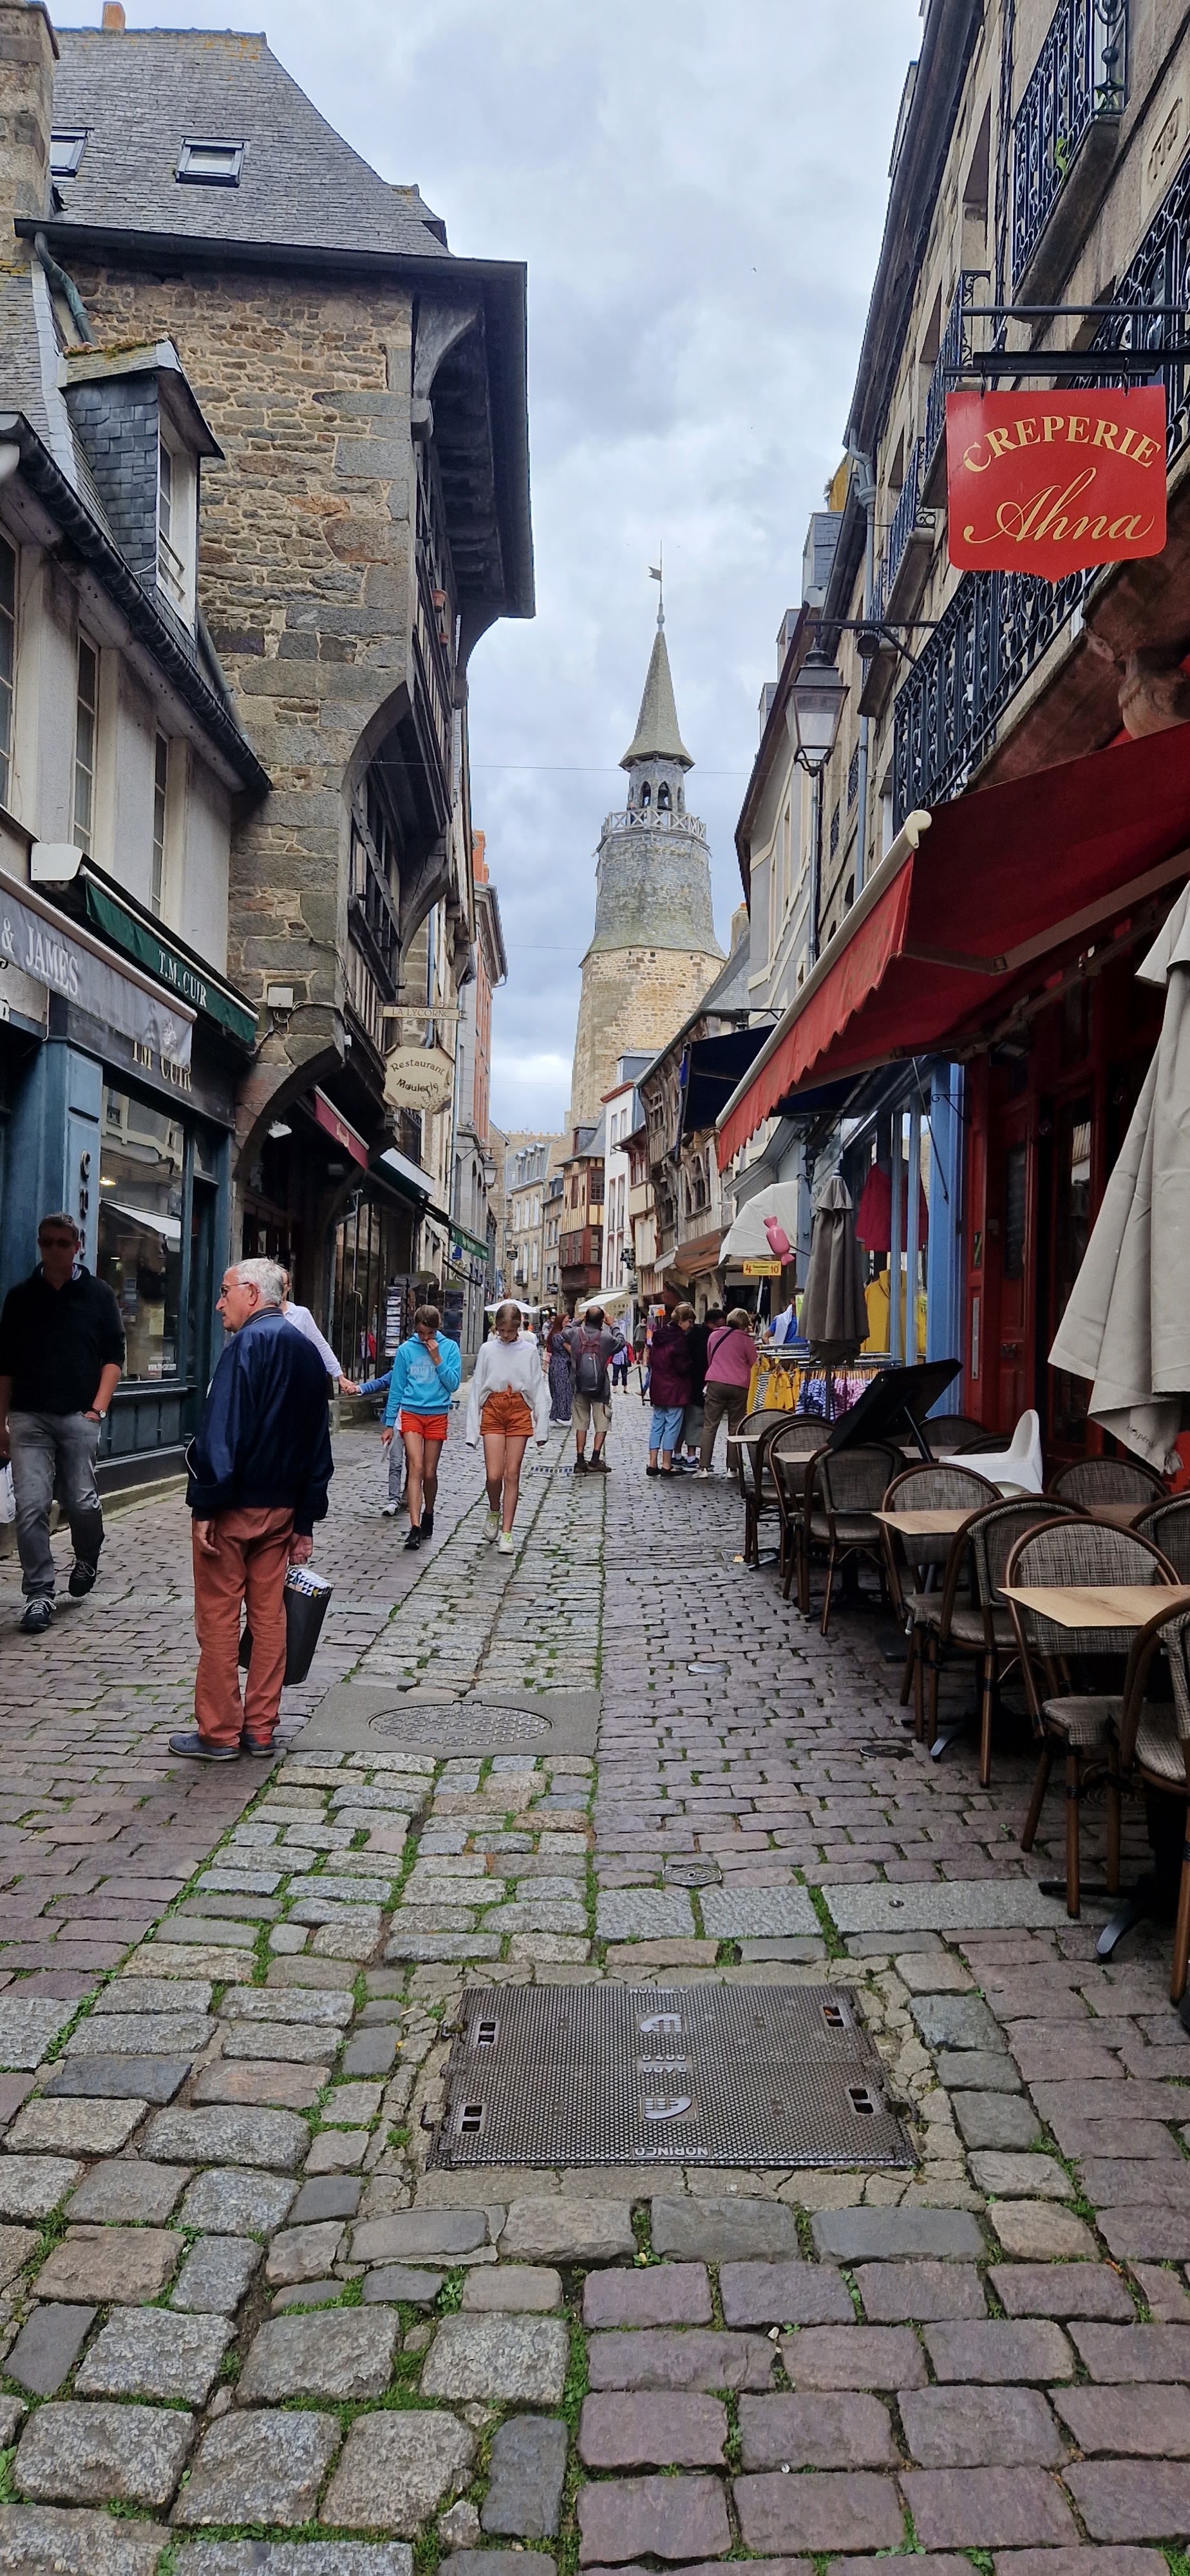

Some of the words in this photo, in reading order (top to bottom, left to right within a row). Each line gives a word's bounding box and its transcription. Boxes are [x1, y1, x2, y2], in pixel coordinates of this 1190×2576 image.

[963, 416, 1162, 473] CREPERIE
[963, 467, 1155, 544] Ahna
[1, 917, 14, 953] &
[26, 924, 78, 995] JAMES
[158, 949, 181, 987] T.M.
[183, 971, 207, 1008] CUIR
[407, 1008, 449, 1018] LYCORNE
[160, 1056, 192, 1092] CUIR
[390, 1059, 446, 1075] Restaurant
[396, 1078, 439, 1092] Moulerie
[634, 2146, 709, 2157] NORINCO
